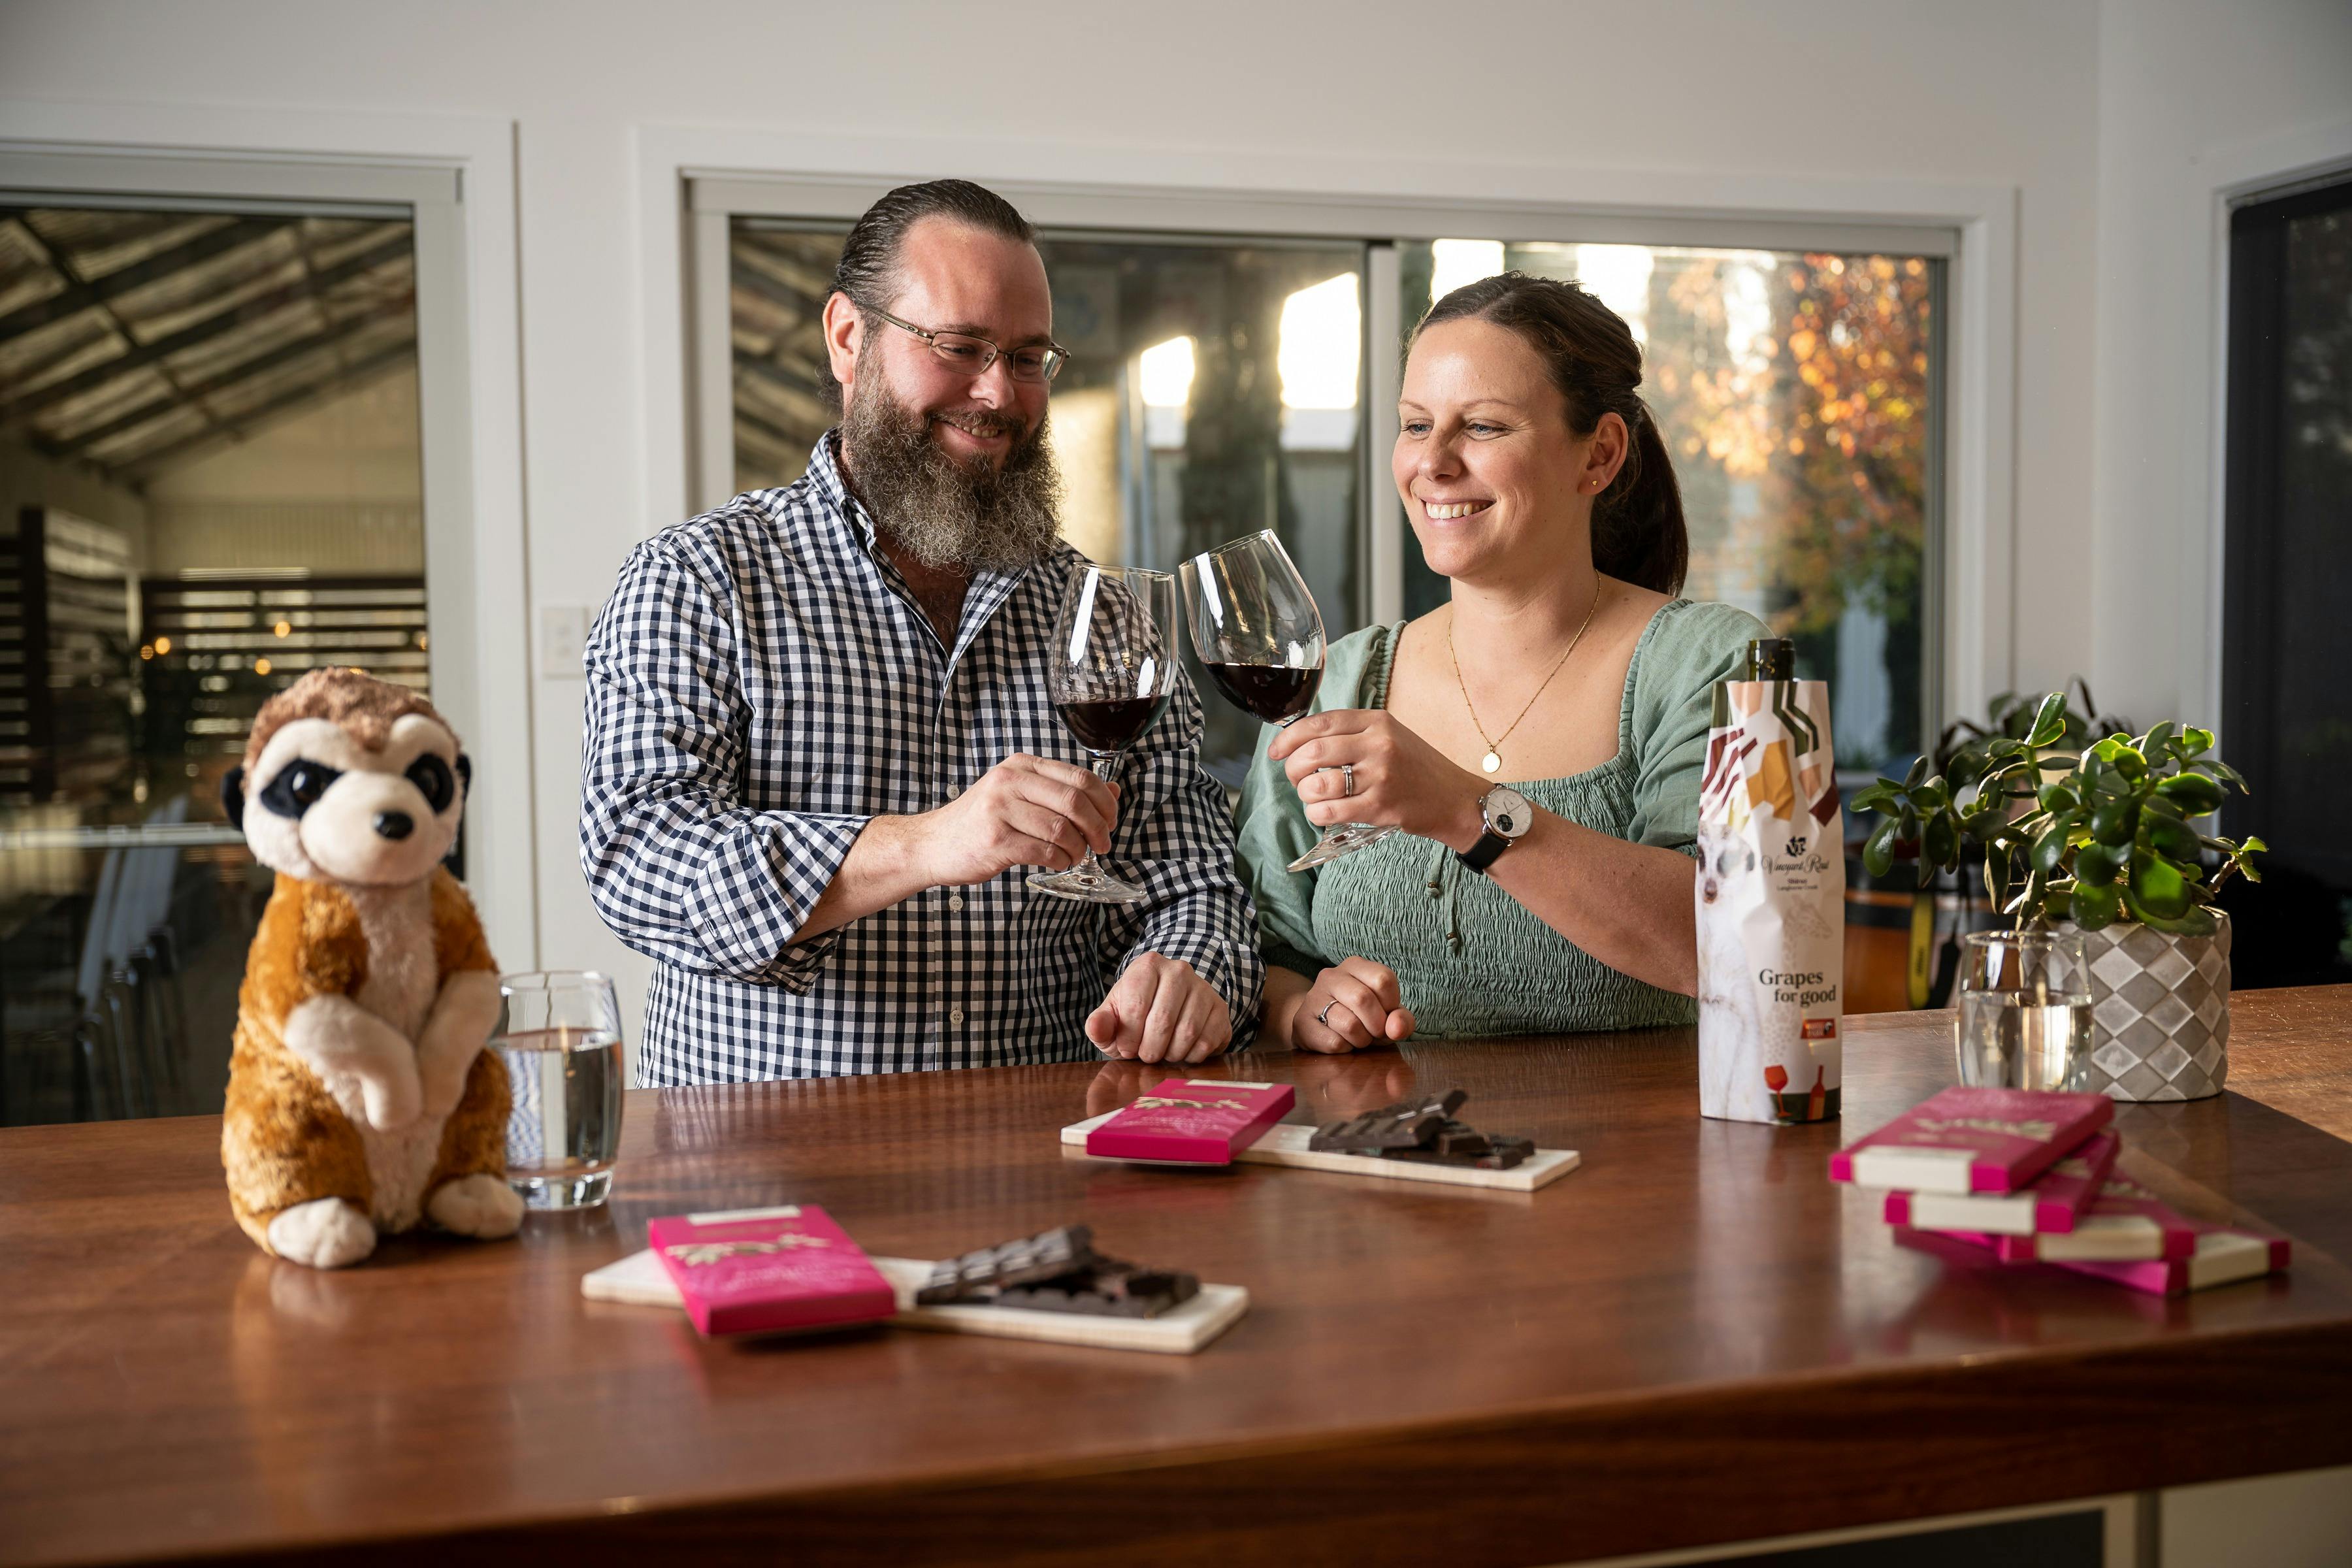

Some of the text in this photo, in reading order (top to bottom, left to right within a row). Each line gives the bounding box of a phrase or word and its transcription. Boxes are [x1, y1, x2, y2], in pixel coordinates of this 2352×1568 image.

[1759, 968, 1823, 989] Grapes
[1774, 985, 1836, 1007] for good
